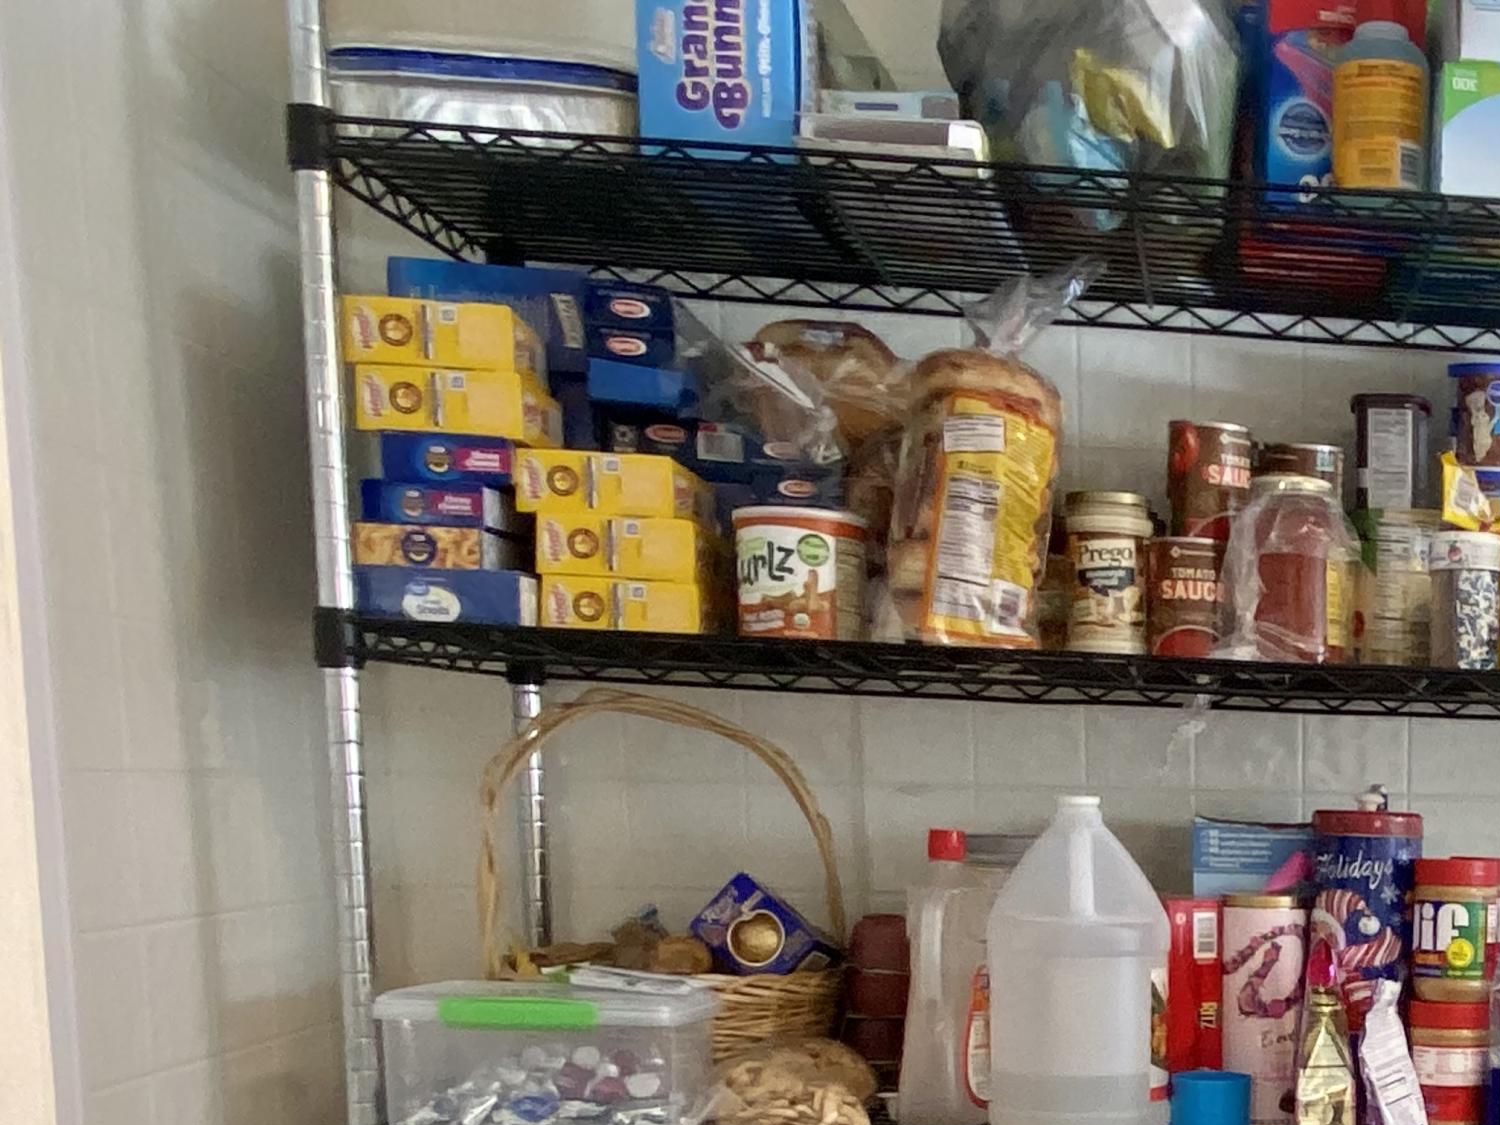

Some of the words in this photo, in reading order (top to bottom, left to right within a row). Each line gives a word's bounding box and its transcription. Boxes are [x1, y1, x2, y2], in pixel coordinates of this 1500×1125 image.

[675, 0, 710, 112] Gran
[1078, 543, 1133, 567] Prego
[1171, 567, 1216, 581] TOMATO
